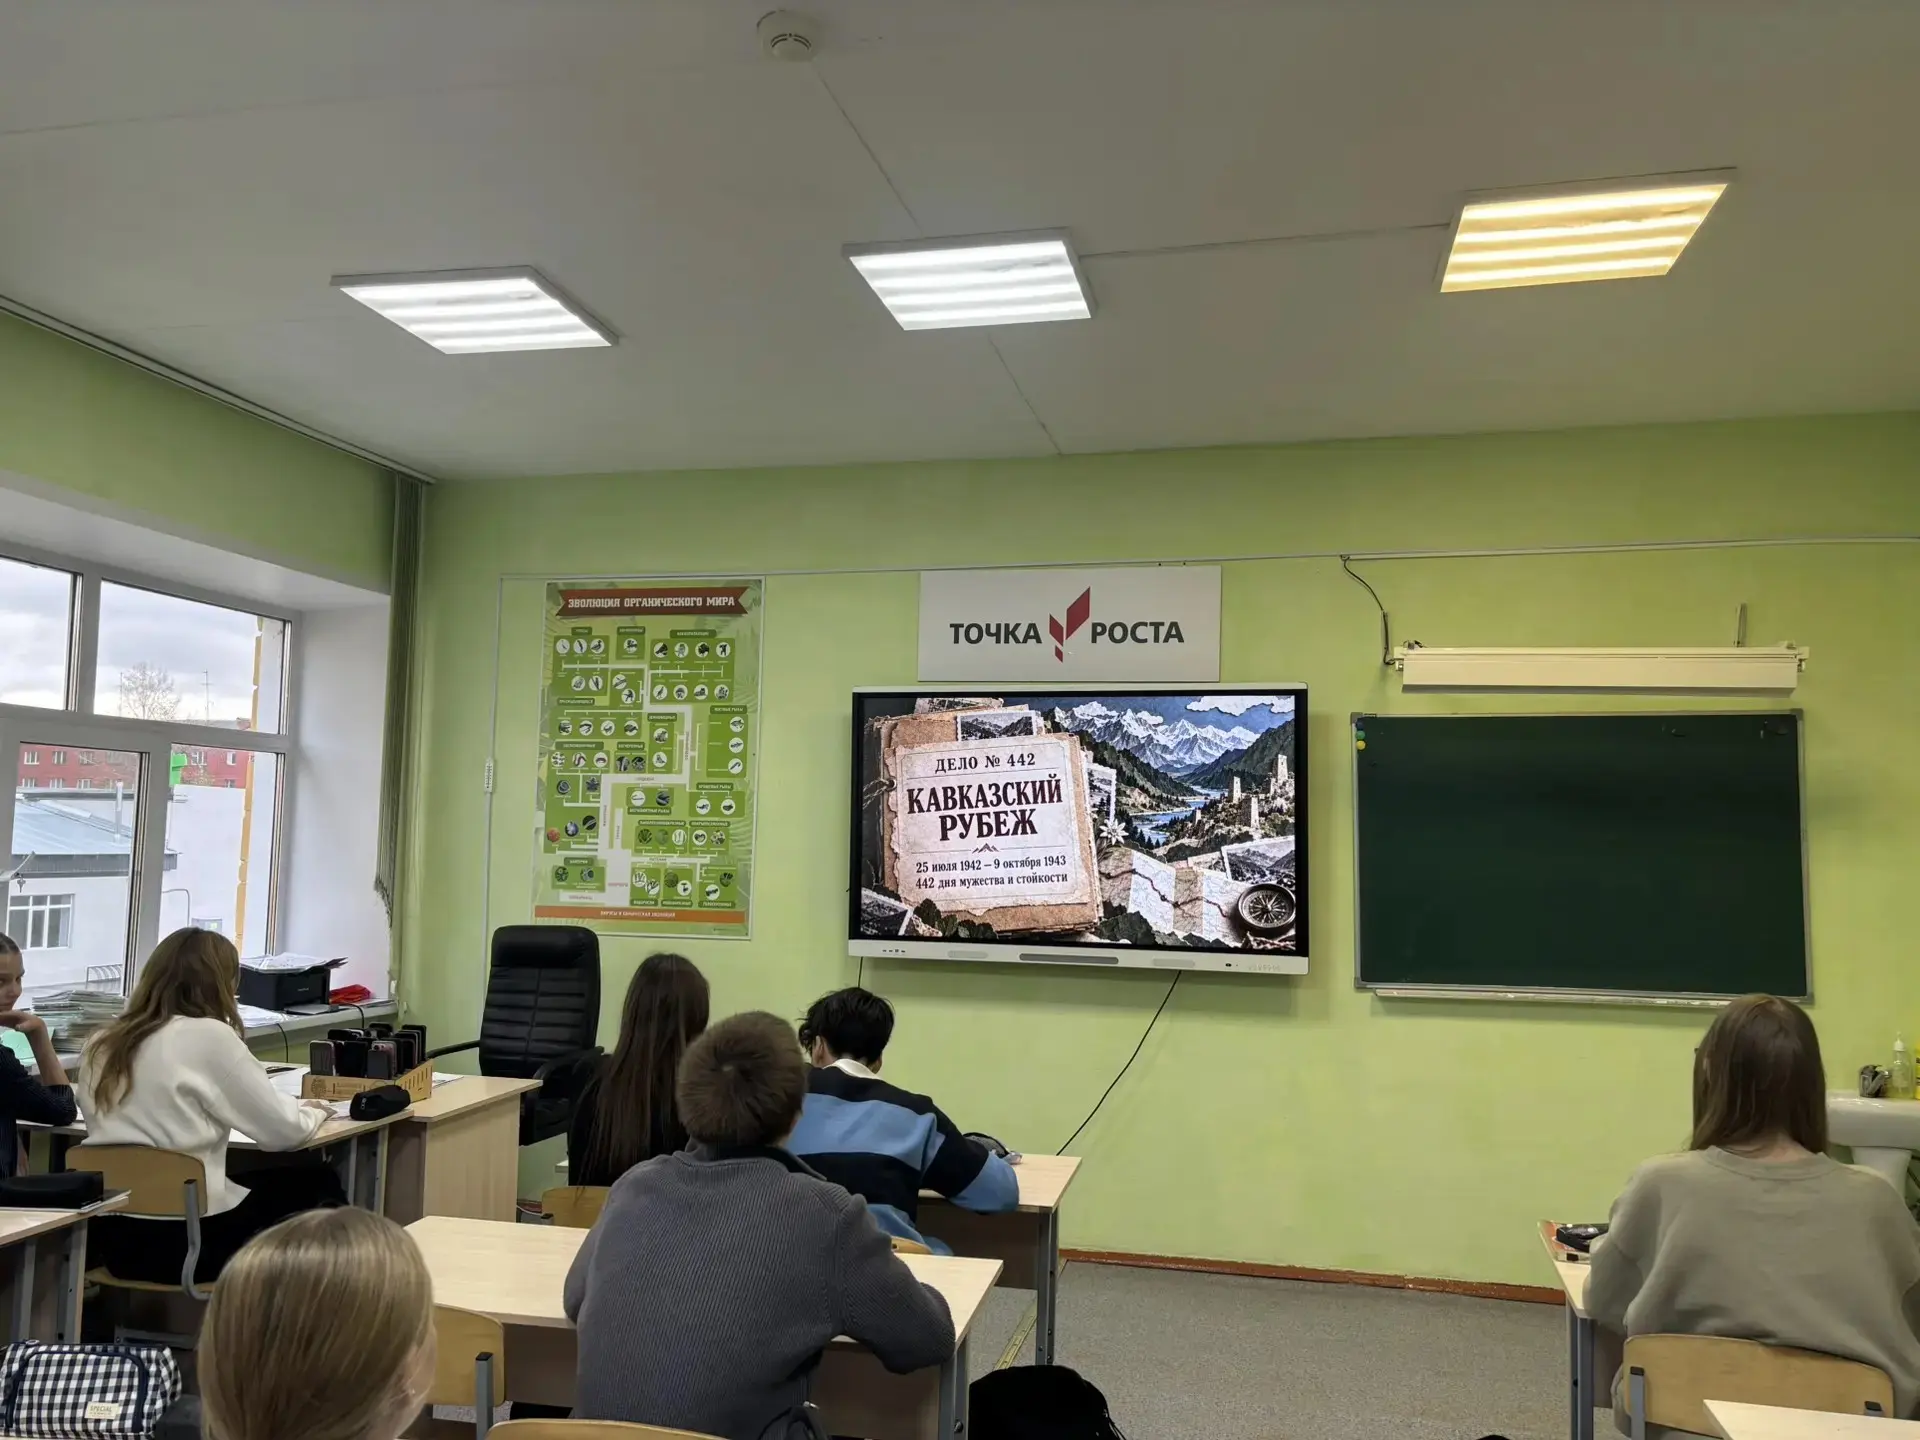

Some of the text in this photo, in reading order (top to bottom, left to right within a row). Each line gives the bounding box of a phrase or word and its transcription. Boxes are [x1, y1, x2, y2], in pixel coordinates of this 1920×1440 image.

[568, 596, 735, 609] ЭВОЛЮЦИЯ ОРГАНИЧЕСКОГО МИРА
[949, 621, 1185, 645] ТОЧКА РОСТА
[935, 753, 1036, 774] ДЕЛО № 442
[906, 773, 1063, 815] КАВКАЗСКИЙ
[938, 809, 1038, 841] РУБЕЖ
[916, 862, 928, 873] 25
[932, 862, 957, 872] июля
[960, 859, 982, 871] 1942
[994, 859, 1000, 868] 9
[1003, 857, 1042, 869] октября
[1044, 855, 1066, 867] 1943
[915, 877, 935, 890] 442
[937, 878, 957, 889] дня
[959, 876, 1005, 888] мужества
[1016, 872, 1068, 885] стойкости
